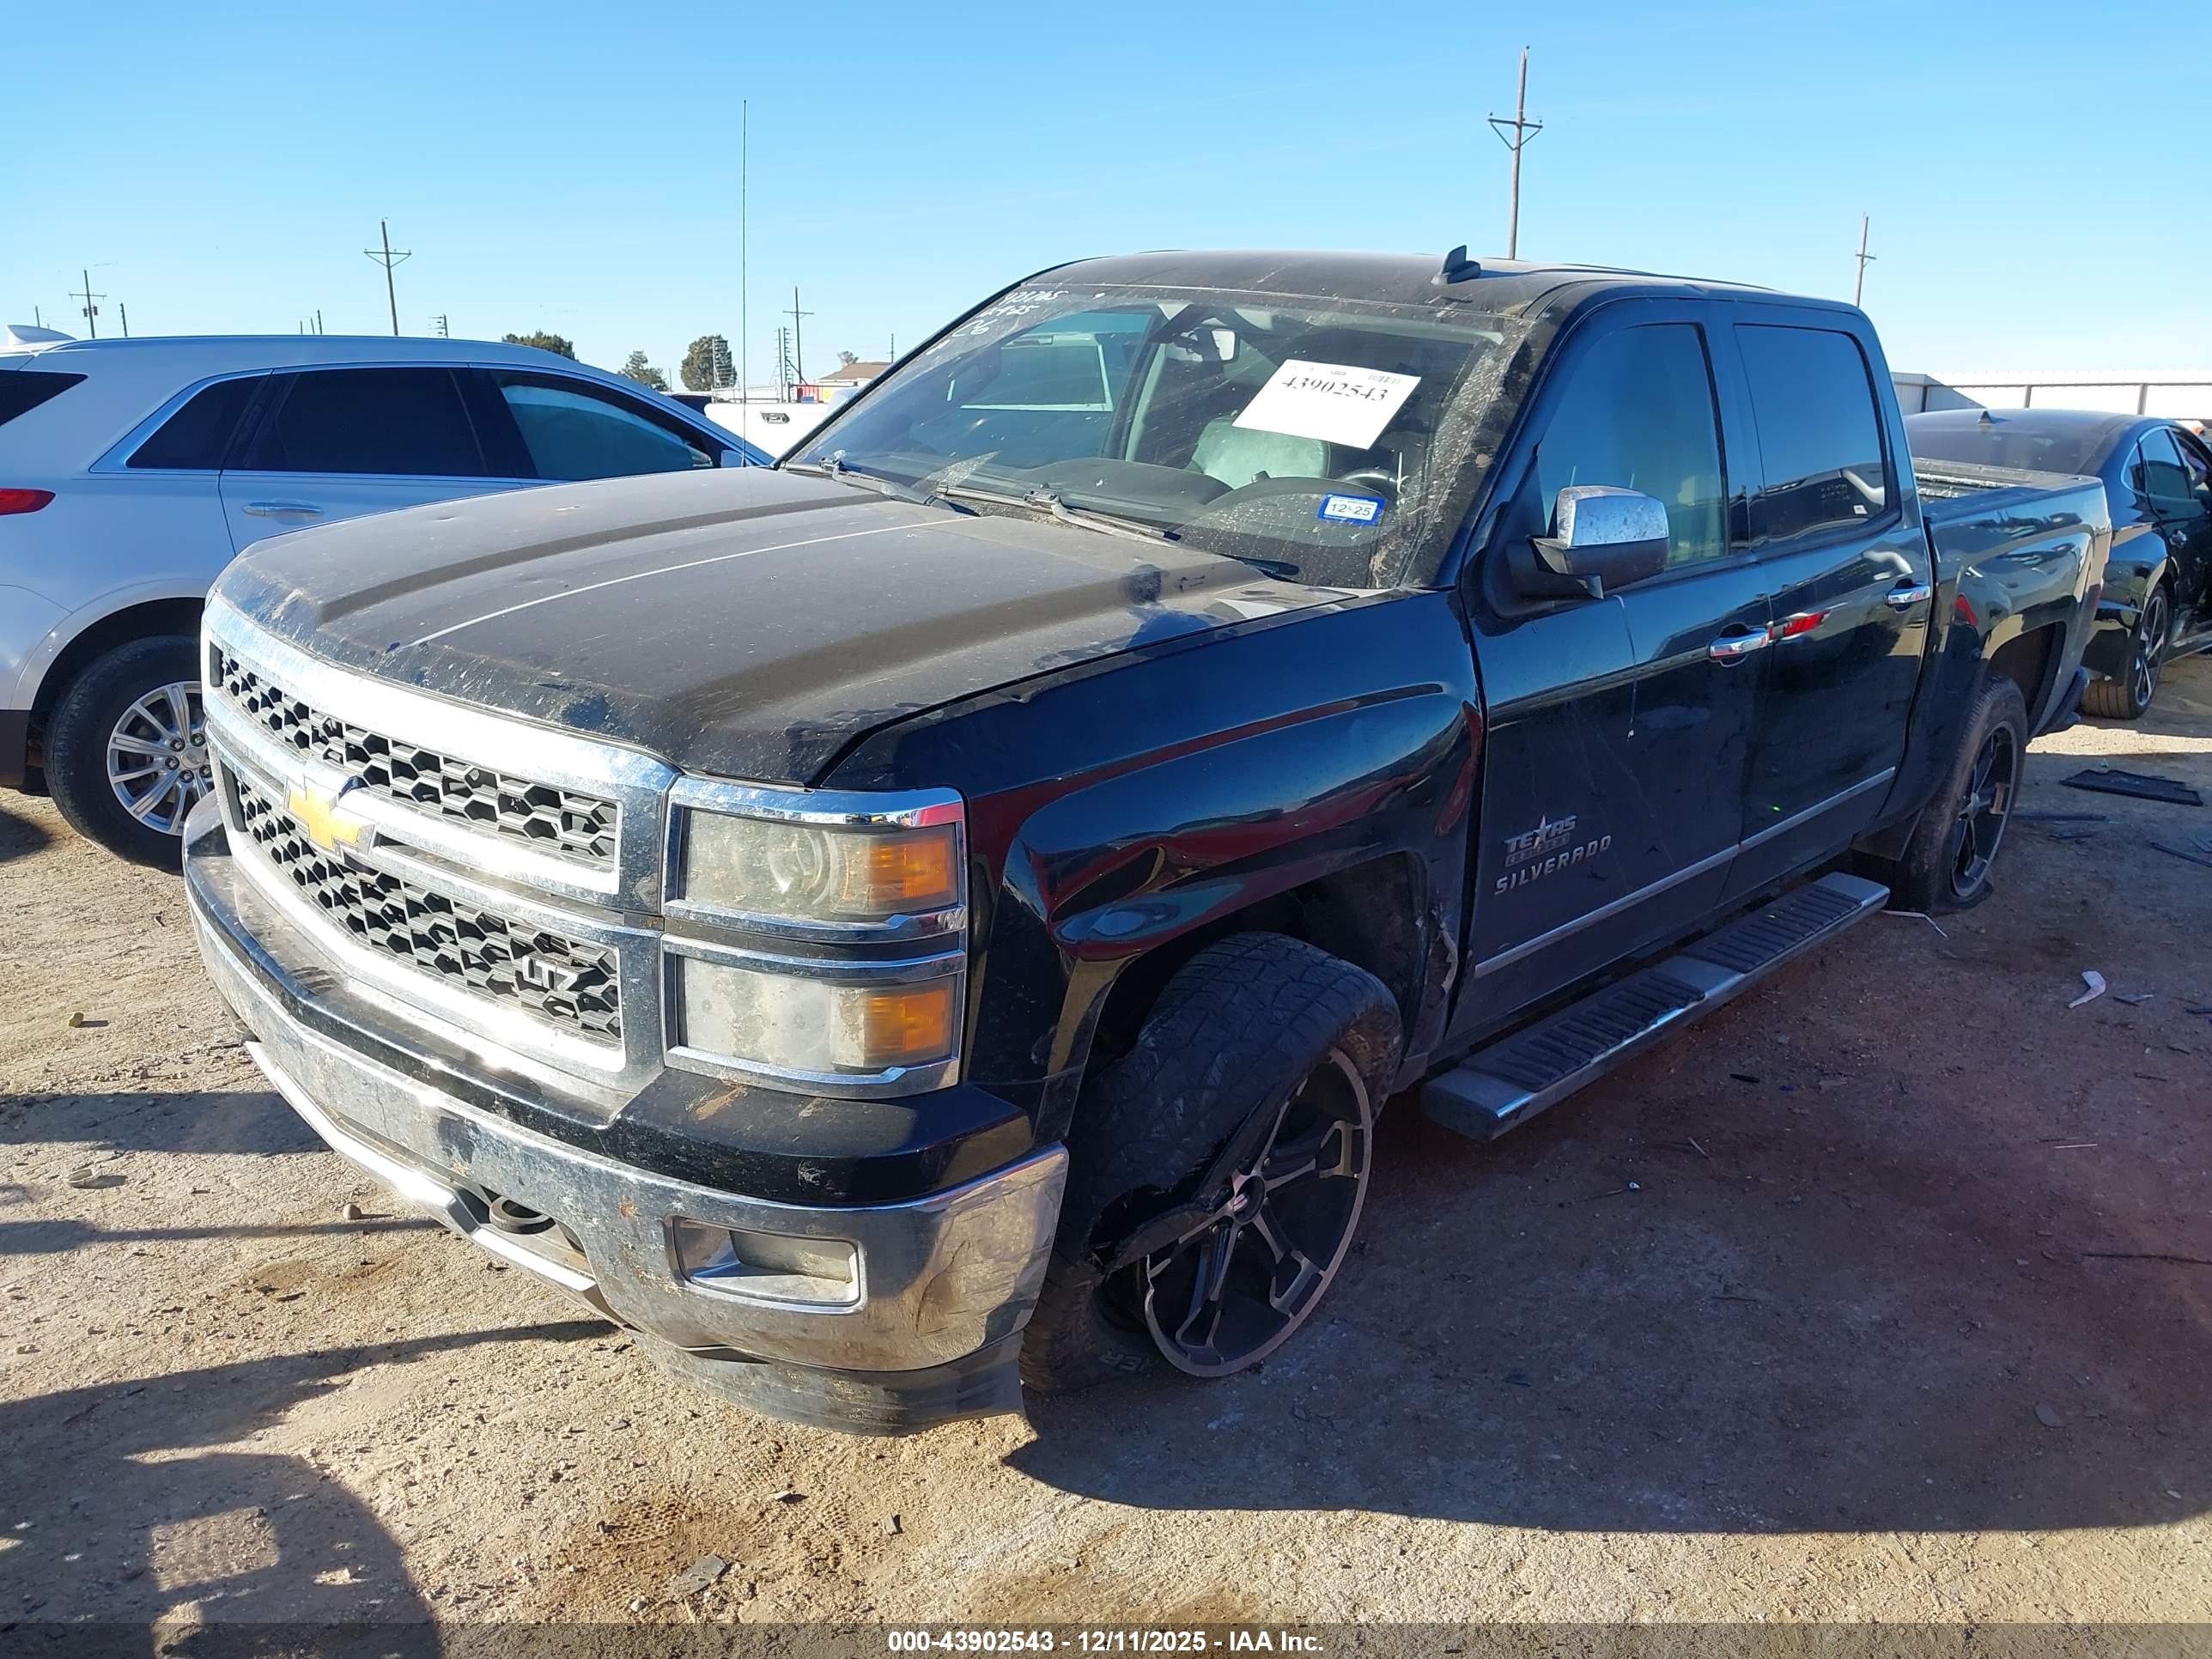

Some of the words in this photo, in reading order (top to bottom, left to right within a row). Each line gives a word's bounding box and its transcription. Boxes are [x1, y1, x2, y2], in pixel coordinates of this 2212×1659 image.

[1282, 375, 1389, 402] 43902543
[1504, 815, 1577, 854] TEXAS
[1494, 835, 1612, 896] SILVERADO
[522, 955, 579, 1000] LTZ
